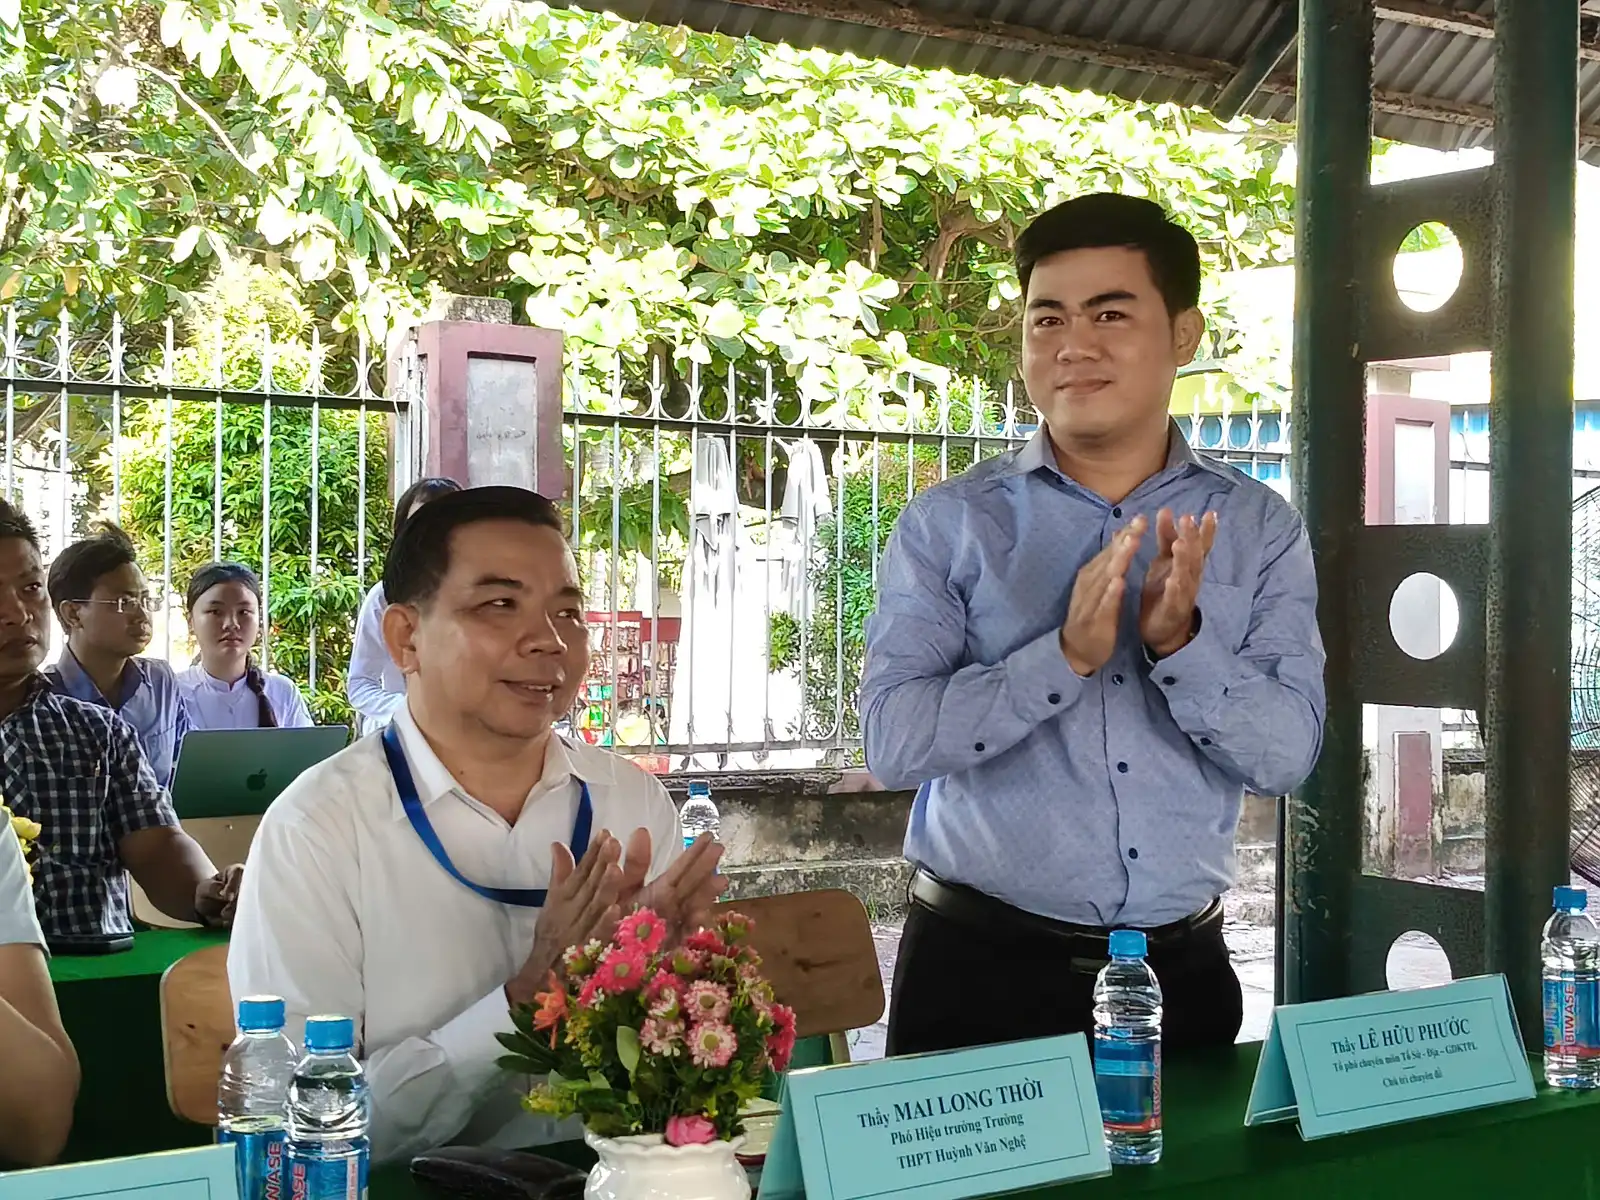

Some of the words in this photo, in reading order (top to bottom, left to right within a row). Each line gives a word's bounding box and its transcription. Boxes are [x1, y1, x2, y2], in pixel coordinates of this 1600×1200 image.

[1563, 984, 1576, 1044] BIWASE
[1331, 1036, 1357, 1055] Thầy
[1358, 1027, 1380, 1050] LÊ
[1382, 1024, 1414, 1047] HỮU
[1418, 1016, 1471, 1041] PHƯỚC
[857, 1106, 891, 1128] Thầy
[893, 1097, 935, 1123] MAI
[938, 1088, 993, 1114] LONG
[996, 1077, 1045, 1105] THỜI
[890, 1130, 913, 1146] Phó
[915, 1125, 942, 1142] Hiệu
[944, 1120, 983, 1135] trưởng
[983, 1112, 1025, 1129] Trường
[897, 1151, 933, 1169] THPT
[935, 1144, 973, 1163] Huỳnh
[975, 1141, 998, 1155] Văn
[999, 1134, 1028, 1152] Nghệ
